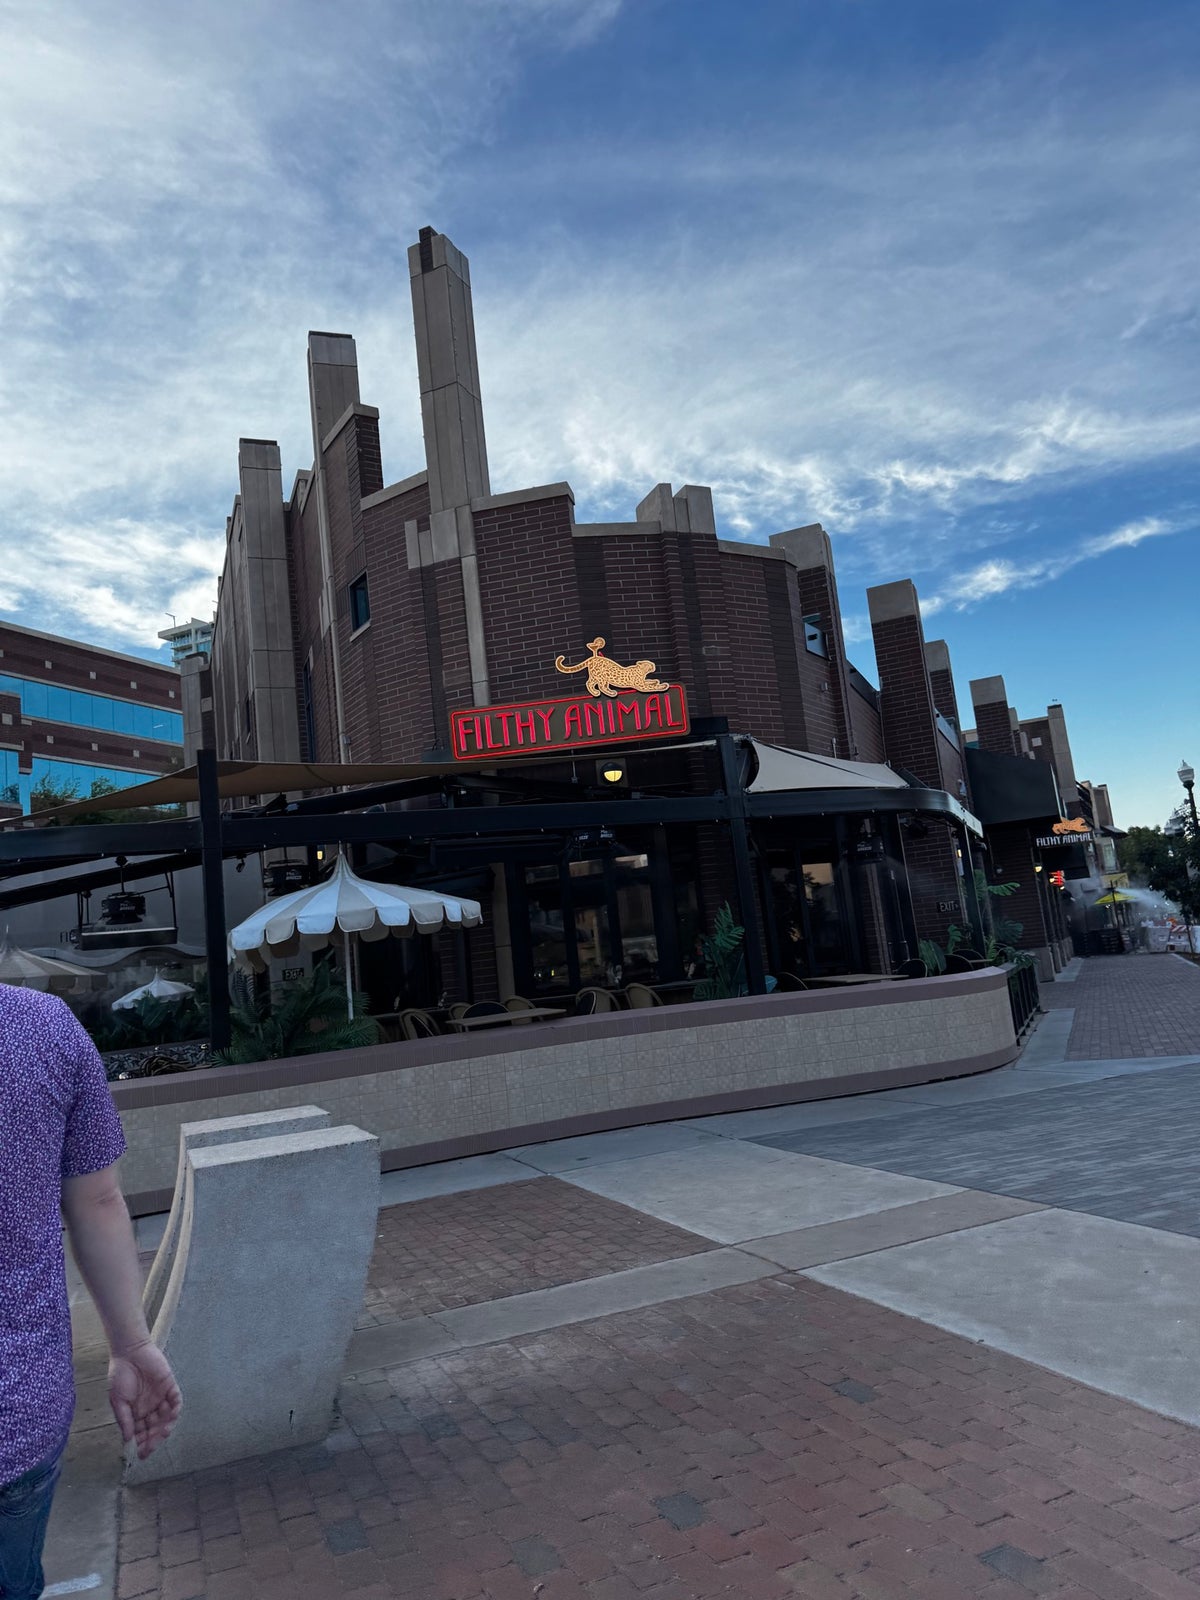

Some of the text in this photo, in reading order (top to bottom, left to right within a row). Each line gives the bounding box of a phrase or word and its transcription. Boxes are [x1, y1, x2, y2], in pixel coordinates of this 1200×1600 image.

[457, 694, 682, 752] FILTHY ANIMAL
[1036, 832, 1092, 848] FILTHY ANIMAL
[940, 901, 954, 912] EXIT
[285, 968, 301, 980] EXIT
